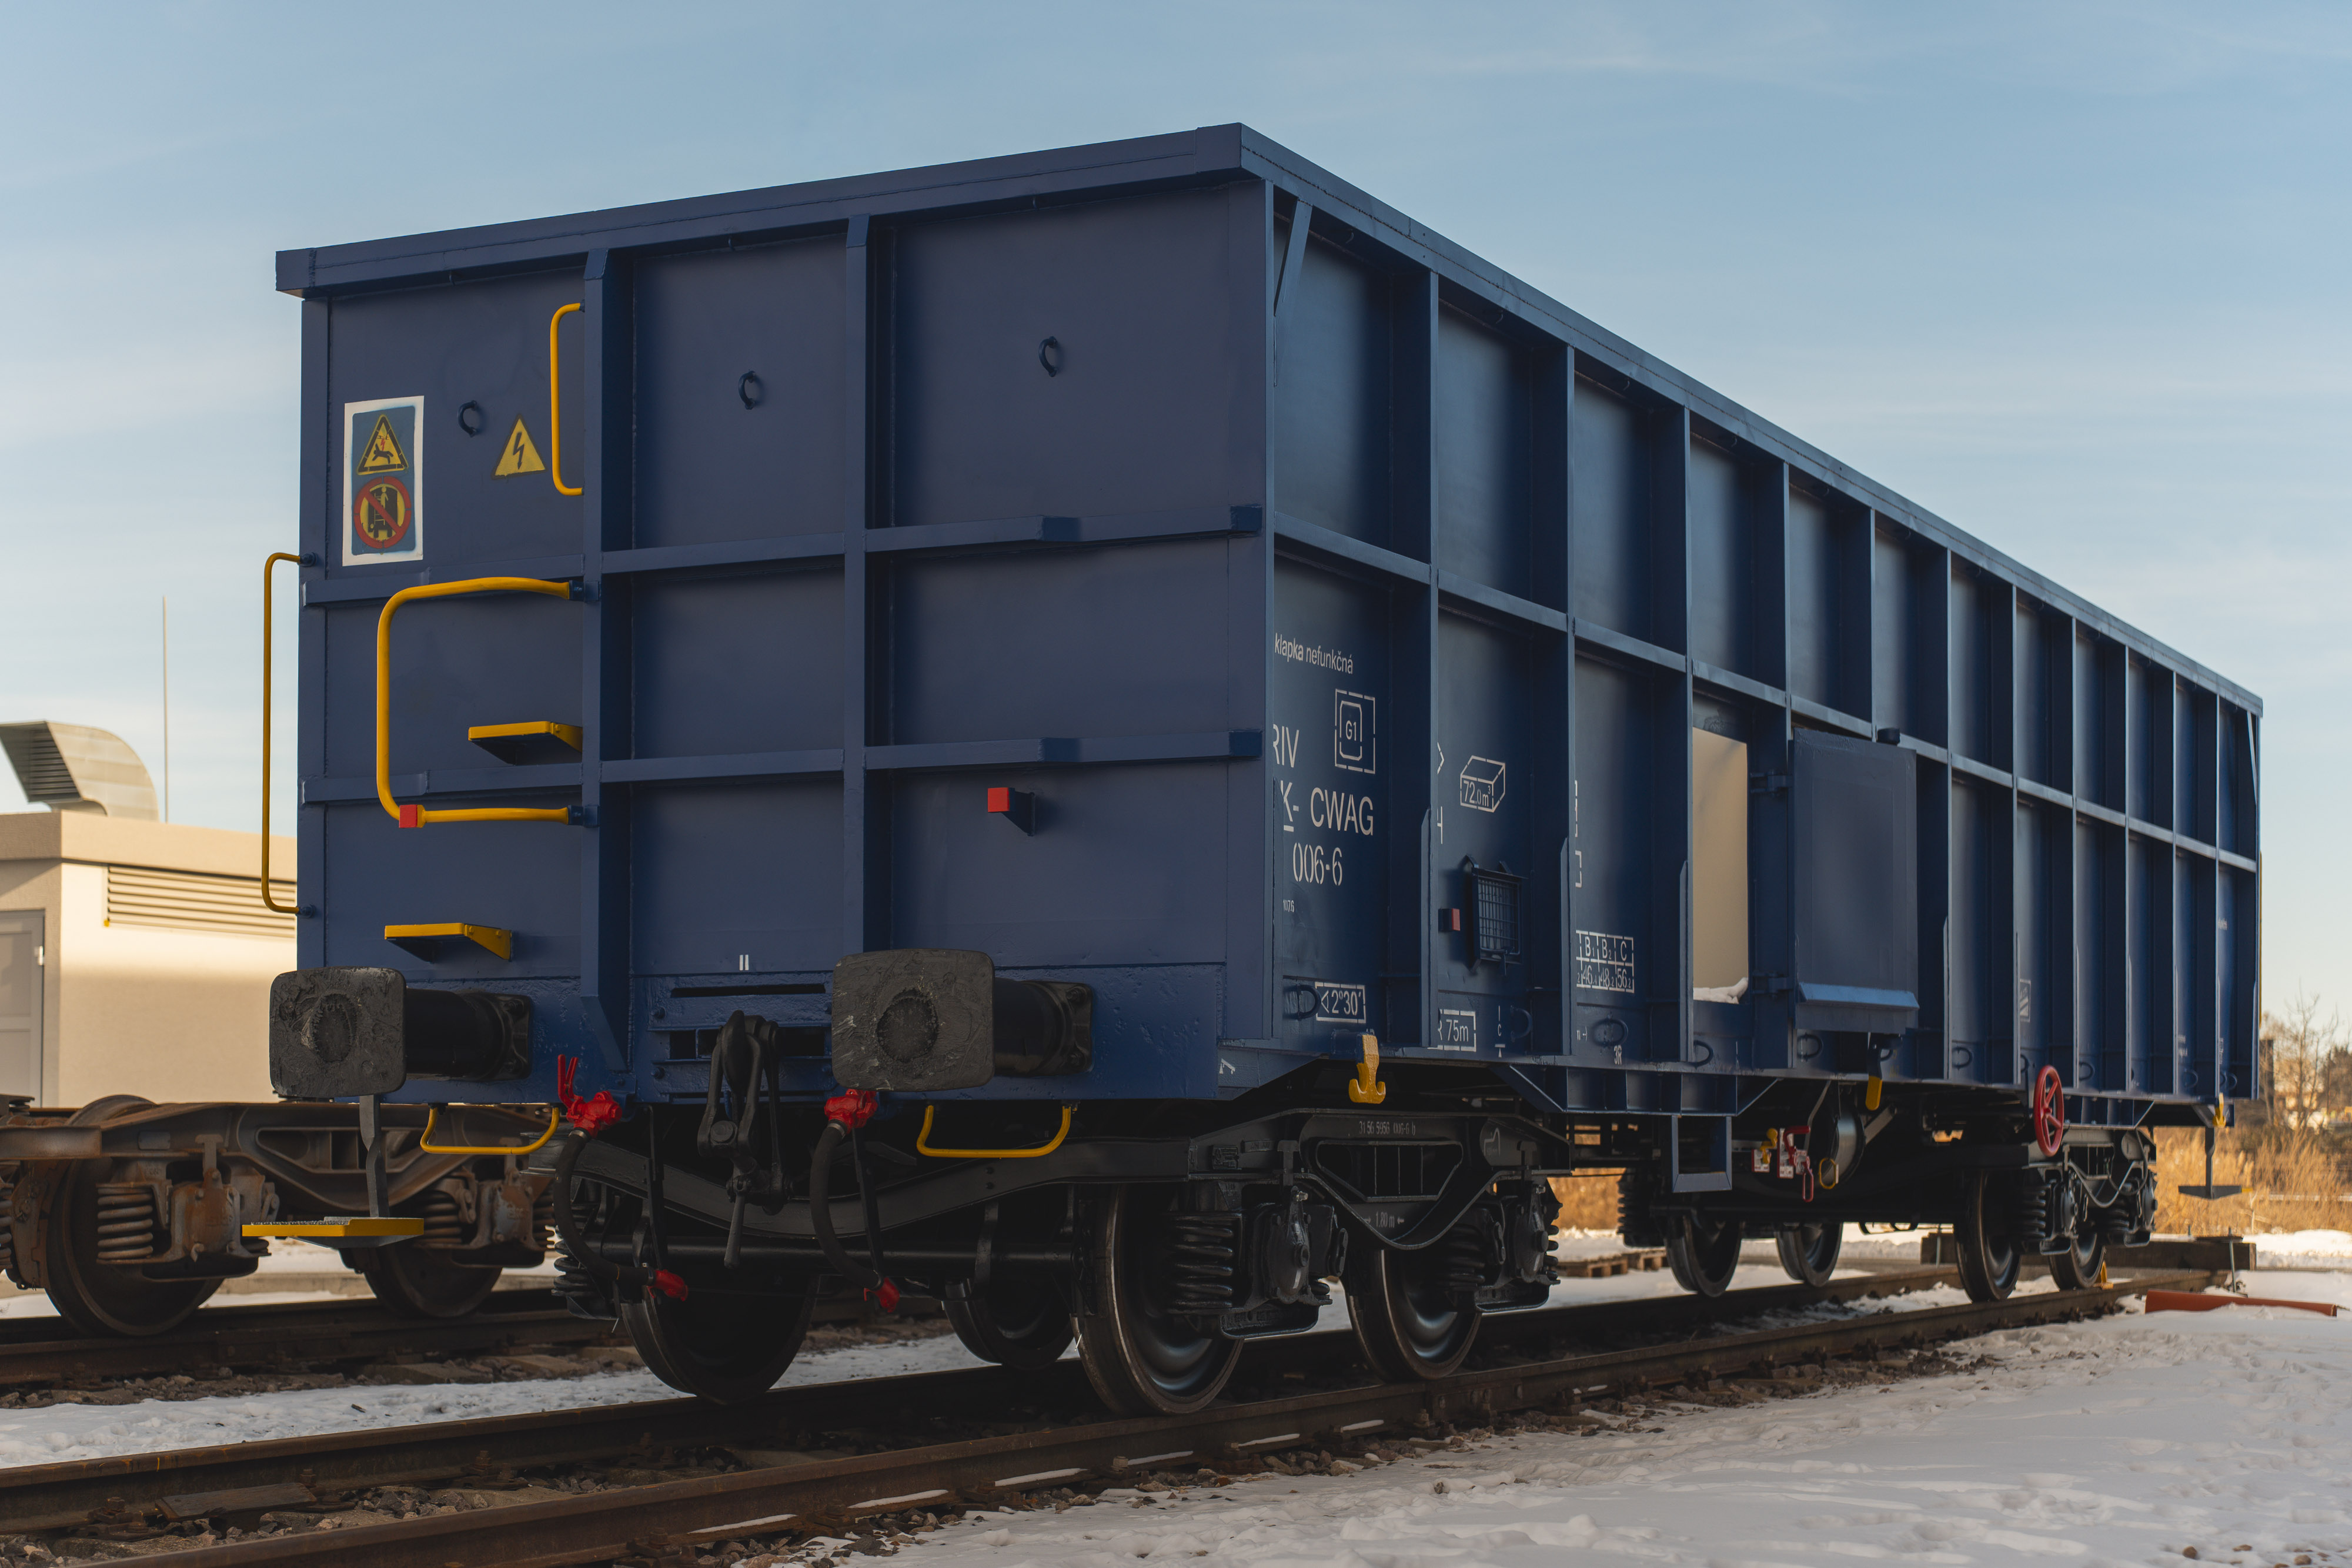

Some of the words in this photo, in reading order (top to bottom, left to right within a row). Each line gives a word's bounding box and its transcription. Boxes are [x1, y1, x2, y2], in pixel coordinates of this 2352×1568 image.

[1275, 632, 1304, 662] klapka
[1306, 644, 1354, 674] nefunkčná
[1345, 720, 1357, 741] G1
[1310, 787, 1374, 835] CWAG
[1293, 842, 1343, 886] 006-6
[1620, 940, 1627, 961] C
[1446, 1018, 1469, 1042] 75m
[1613, 1044, 1622, 1065] 3R
[1375, 1211, 1388, 1228] 1.80
[1389, 1215, 1395, 1228] m
